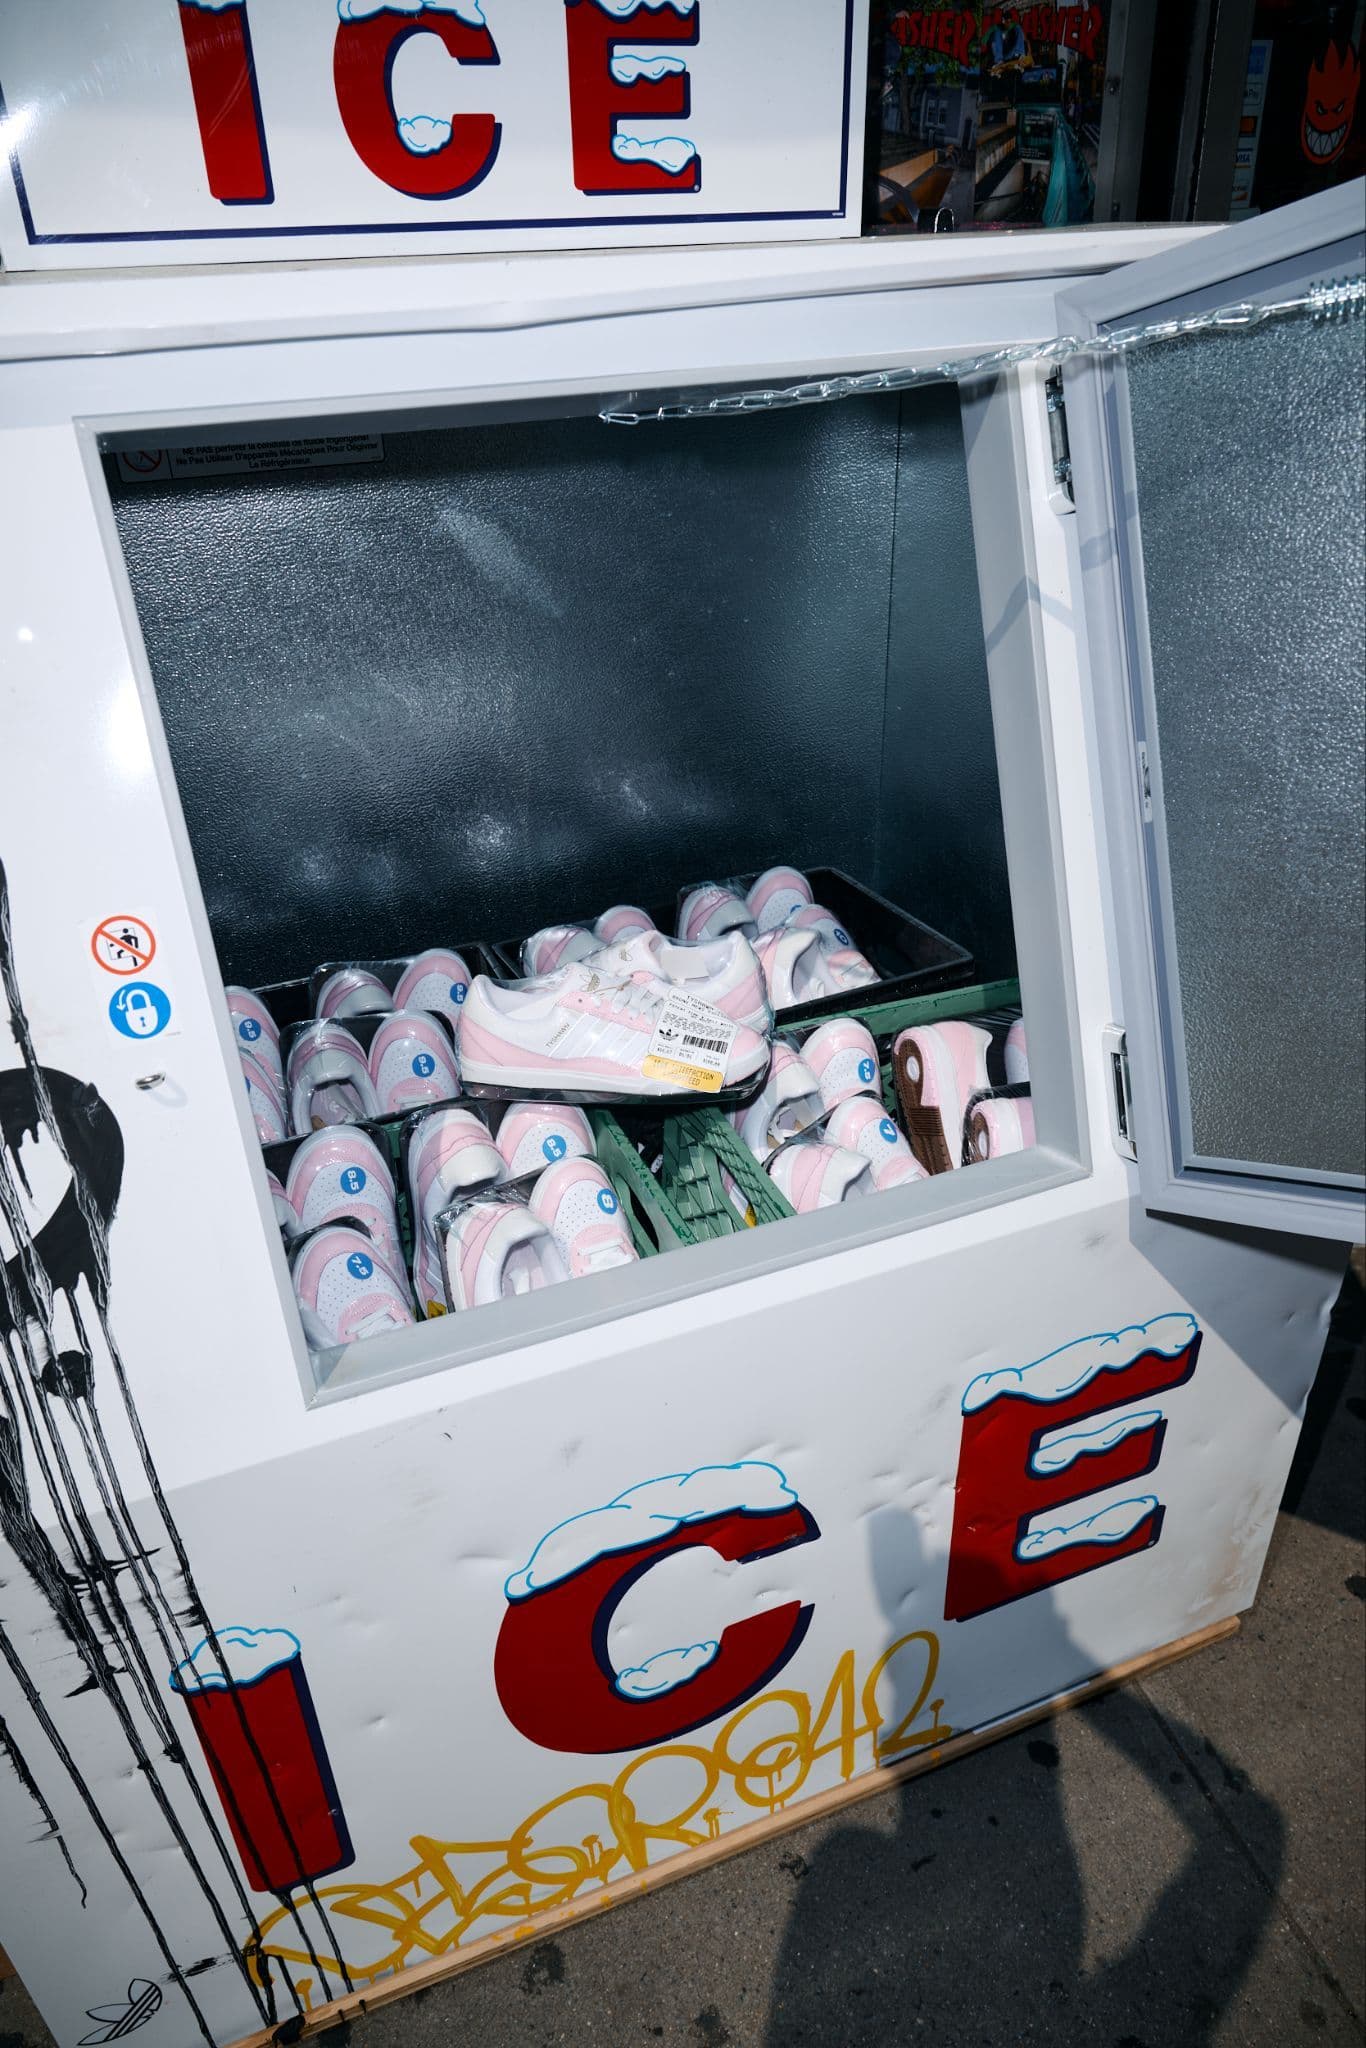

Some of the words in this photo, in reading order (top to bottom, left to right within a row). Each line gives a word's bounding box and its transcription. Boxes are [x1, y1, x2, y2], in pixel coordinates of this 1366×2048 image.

[178, 0, 701, 206] ICE
[189, 456, 205, 465] Pas
[327, 445, 345, 453] Pour
[244, 1020, 256, 1038] 9.5
[418, 1055, 430, 1074] 9.5
[863, 1061, 871, 1080] 7.5
[883, 1123, 896, 1135] 7
[547, 1138, 562, 1157] 8.5
[347, 1170, 359, 1191] 8.5
[600, 1193, 614, 1209] 8
[351, 1256, 368, 1277] 7.5
[172, 1313, 1202, 1892] ICE
